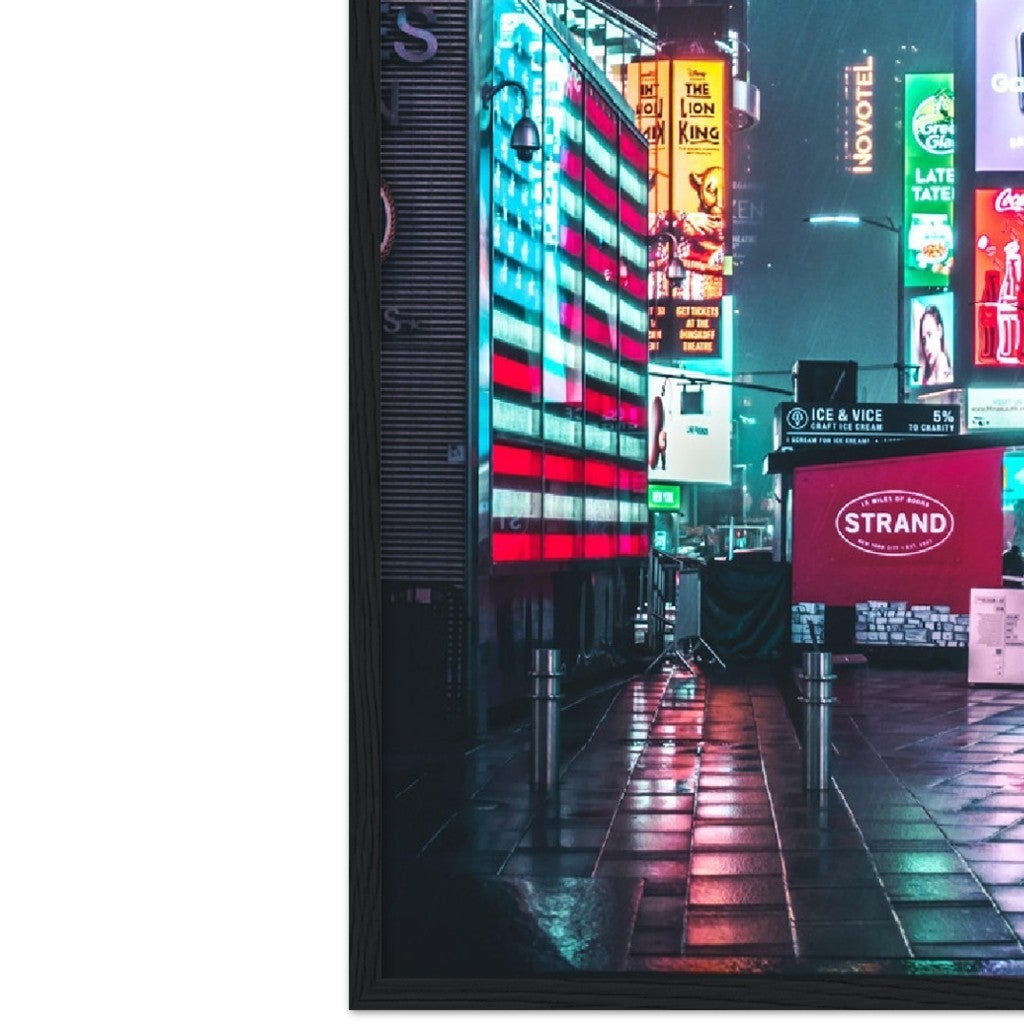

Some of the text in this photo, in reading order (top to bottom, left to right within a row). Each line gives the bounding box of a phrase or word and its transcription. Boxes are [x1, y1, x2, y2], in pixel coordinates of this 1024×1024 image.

[685, 82, 710, 96] THE
[680, 98, 715, 118] LION
[852, 56, 874, 174] NOVOTEL
[678, 120, 720, 145] KING
[676, 307, 690, 317] GET
[690, 307, 719, 317] TICKETS
[686, 319, 710, 328] AT THE
[811, 407, 882, 423] ICE & VICE
[933, 410, 955, 423] 5%
[810, 423, 883, 432] CRAFT ICE CREAM
[909, 424, 955, 433] TO CHARITY
[871, 496, 893, 504] MILES
[906, 497, 930, 508] BOOKS
[844, 512, 948, 534] STRAND
